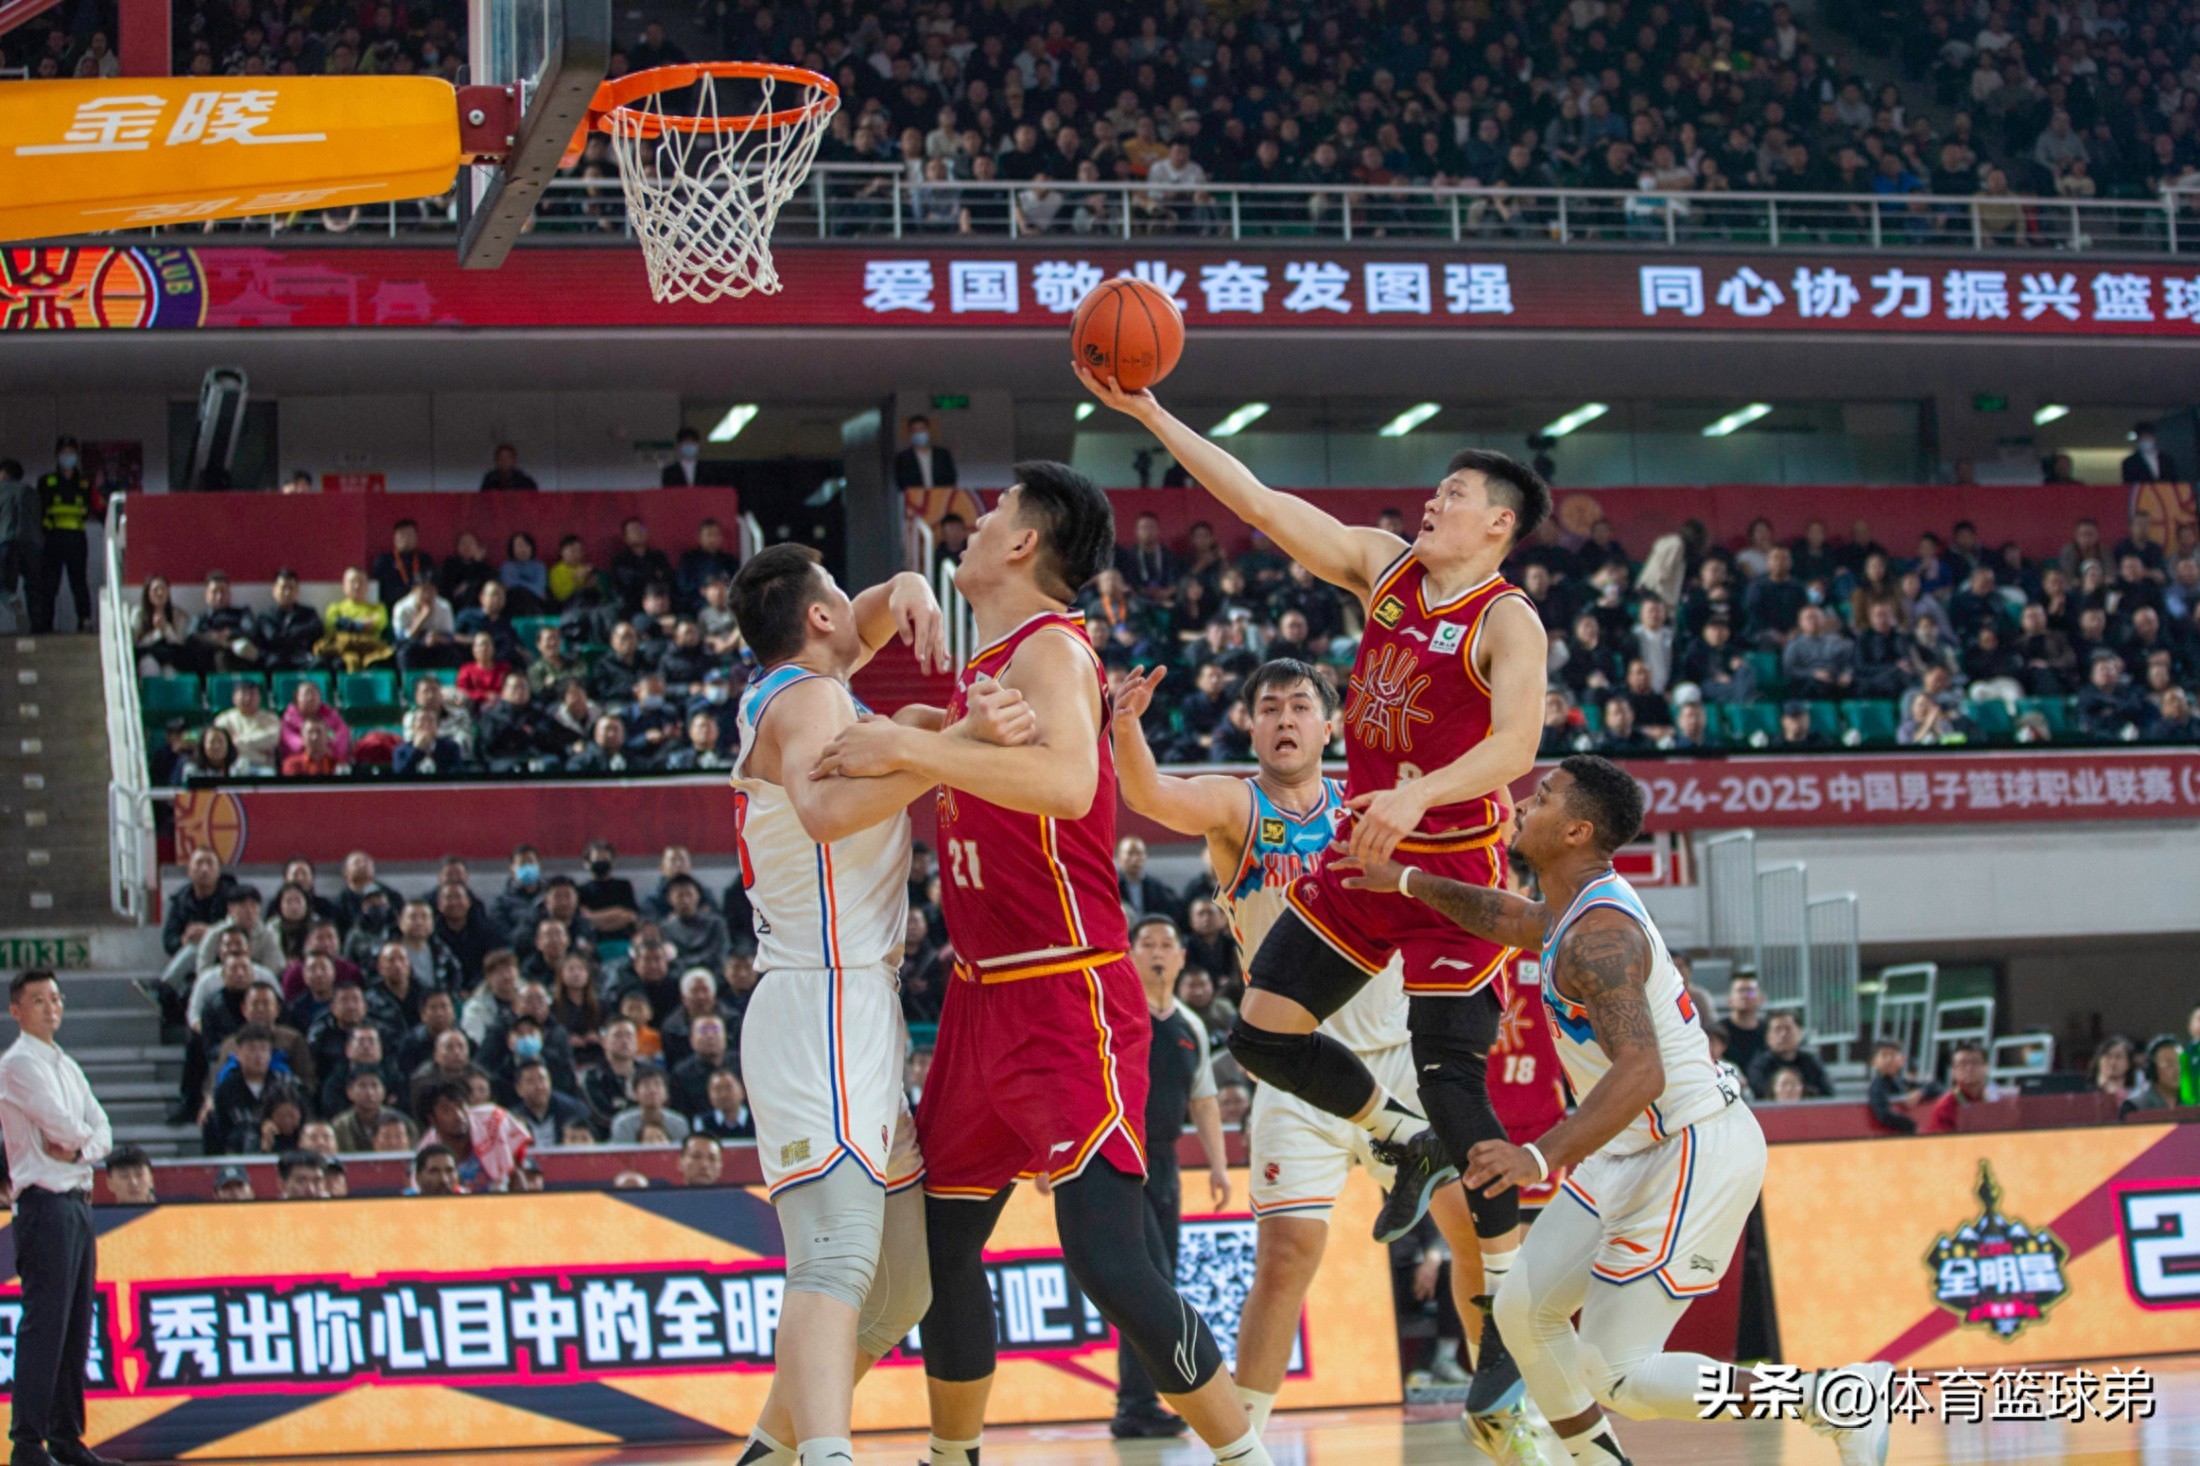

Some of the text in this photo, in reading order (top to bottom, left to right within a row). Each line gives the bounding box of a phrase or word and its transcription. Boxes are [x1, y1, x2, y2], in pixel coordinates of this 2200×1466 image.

[15, 89, 328, 157] 金陵
[863, 260, 2200, 323] 爱国敬业奋发图强 同心协力振兴篮球
[1827, 764, 2200, 813] 中国男子篮球职业联赛(
[948, 837, 985, 890] 21
[1502, 1055, 1537, 1085] 18
[1936, 1253, 2065, 1299] 全明星
